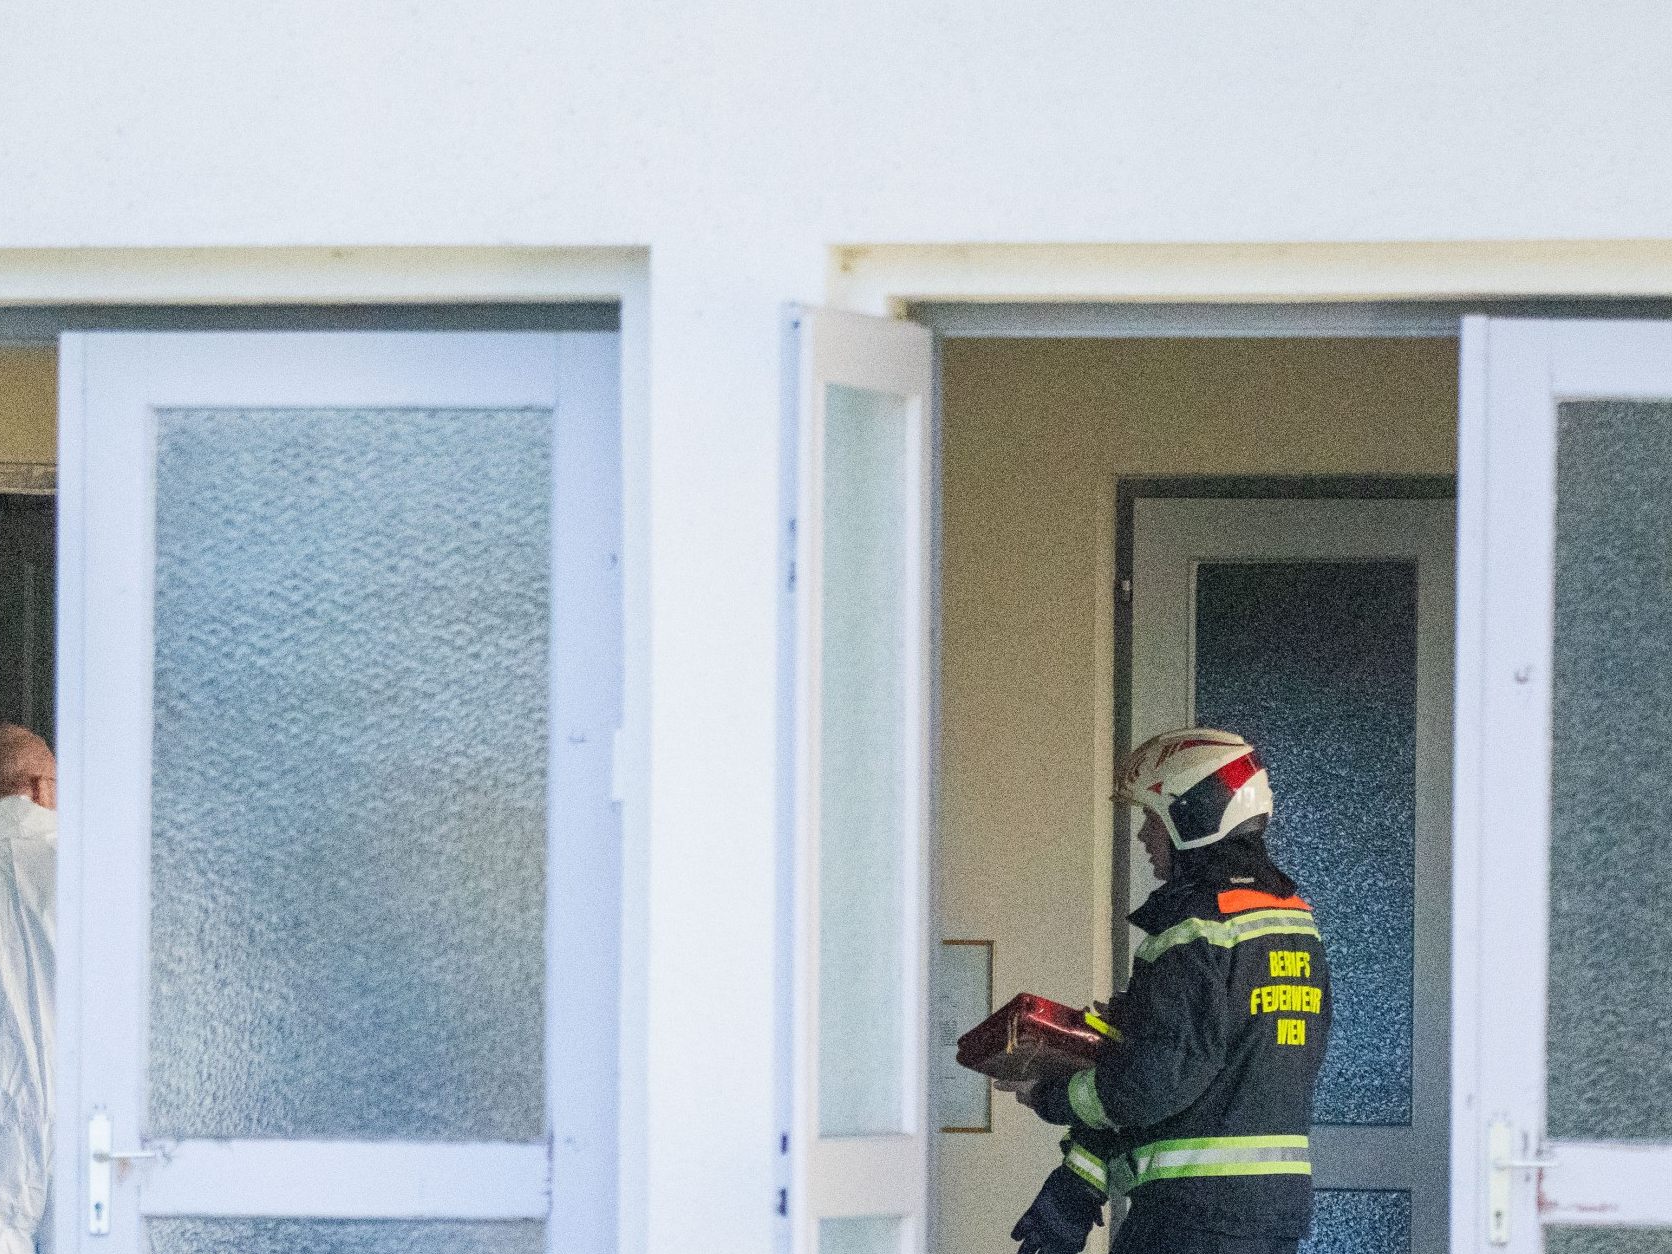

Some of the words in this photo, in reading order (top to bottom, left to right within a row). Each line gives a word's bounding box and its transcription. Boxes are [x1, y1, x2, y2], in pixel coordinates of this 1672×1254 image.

[1269, 951, 1310, 977] BERUFS
[1250, 984, 1322, 1015] FEUERWEHR
[1277, 1018, 1306, 1045] WIEN
